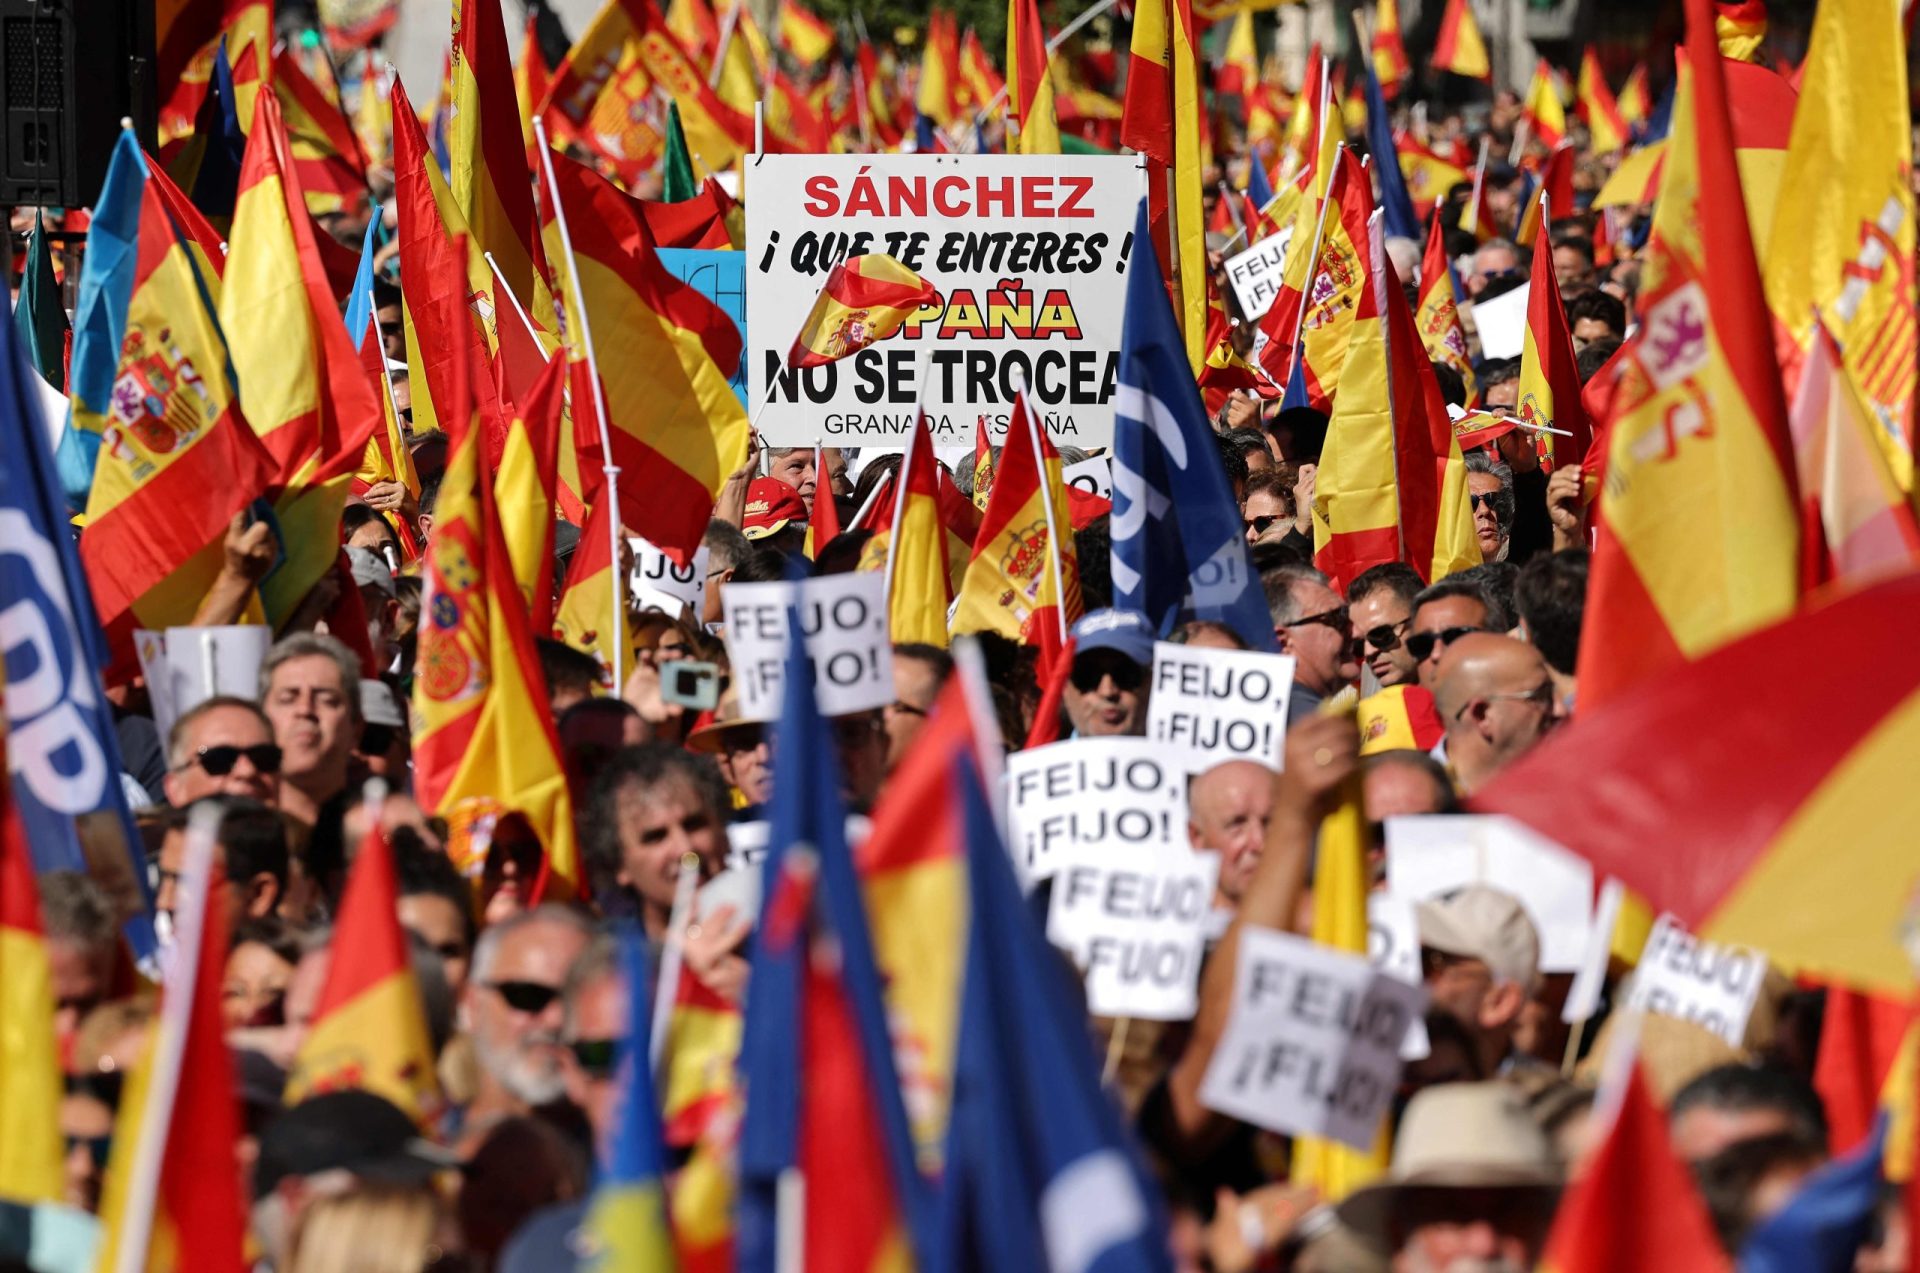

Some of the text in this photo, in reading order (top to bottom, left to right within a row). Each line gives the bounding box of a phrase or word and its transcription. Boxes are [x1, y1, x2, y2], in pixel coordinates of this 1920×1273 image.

[804, 165, 1095, 218] SÁNCHEZ
[790, 230, 874, 277] QUE
[884, 231, 931, 272] TE
[939, 230, 1108, 275] ENTERES
[816, 278, 1083, 341] PAÑA
[765, 350, 839, 404] NO
[854, 349, 916, 405] SE
[732, 595, 884, 641] FEJO,
[746, 647, 881, 704] ¡FO!
[1158, 660, 1282, 711] FEIJO,
[1157, 712, 1273, 756] ¡FIJO!
[1017, 757, 1178, 806] FEIJO,
[1026, 808, 1170, 867] ¡FIJO!
